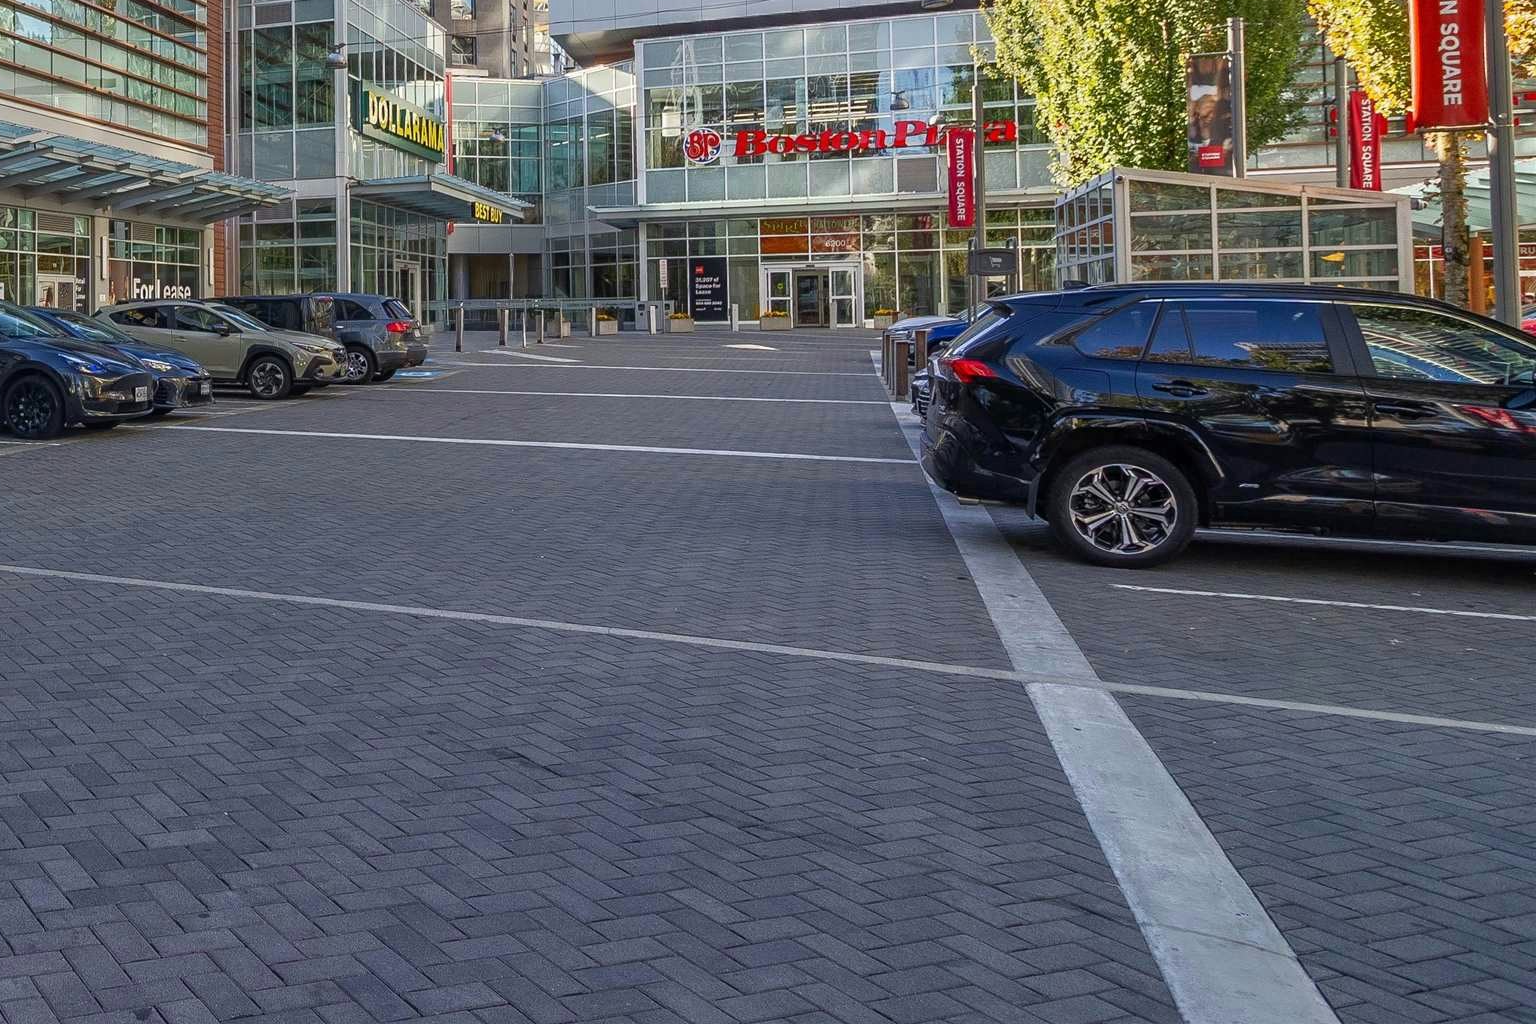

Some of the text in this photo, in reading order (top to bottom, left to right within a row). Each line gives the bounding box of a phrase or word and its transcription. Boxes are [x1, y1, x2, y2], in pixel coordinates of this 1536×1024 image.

[1440, 23, 1462, 106] SQUARE
[368, 90, 446, 153] DOLLARAMA
[733, 119, 1016, 158] Boston Pia
[1361, 99, 1373, 189] STATION SQUARE
[955, 138, 966, 221] STATION SQUARE
[474, 202, 503, 224] BEST BUY
[825, 239, 845, 248] 6200
[133, 278, 191, 299] For Lease
